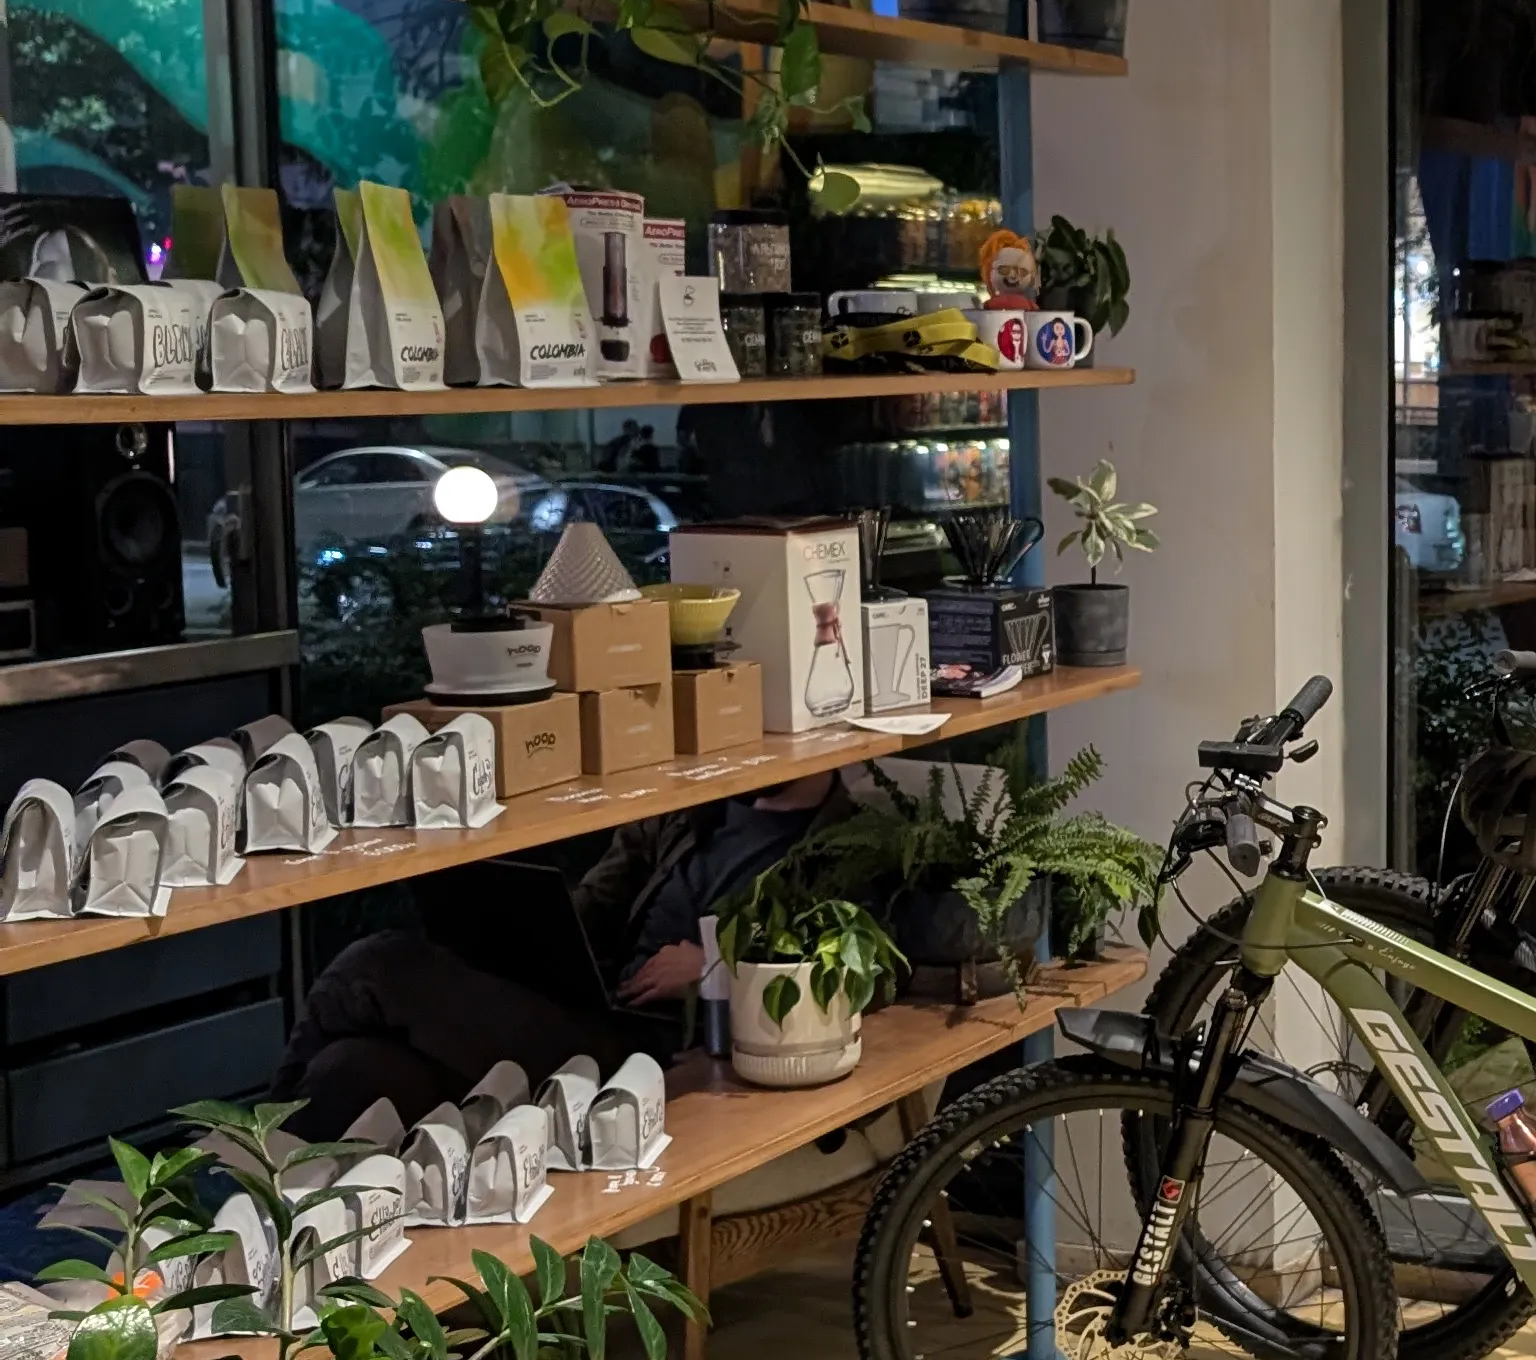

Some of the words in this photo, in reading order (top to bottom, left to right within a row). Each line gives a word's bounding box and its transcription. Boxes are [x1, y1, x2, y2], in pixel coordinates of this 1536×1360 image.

[529, 342, 586, 361] COLOMBIA
[803, 540, 846, 562] CHEMEX
[1132, 1200, 1178, 1287] GESTALT
